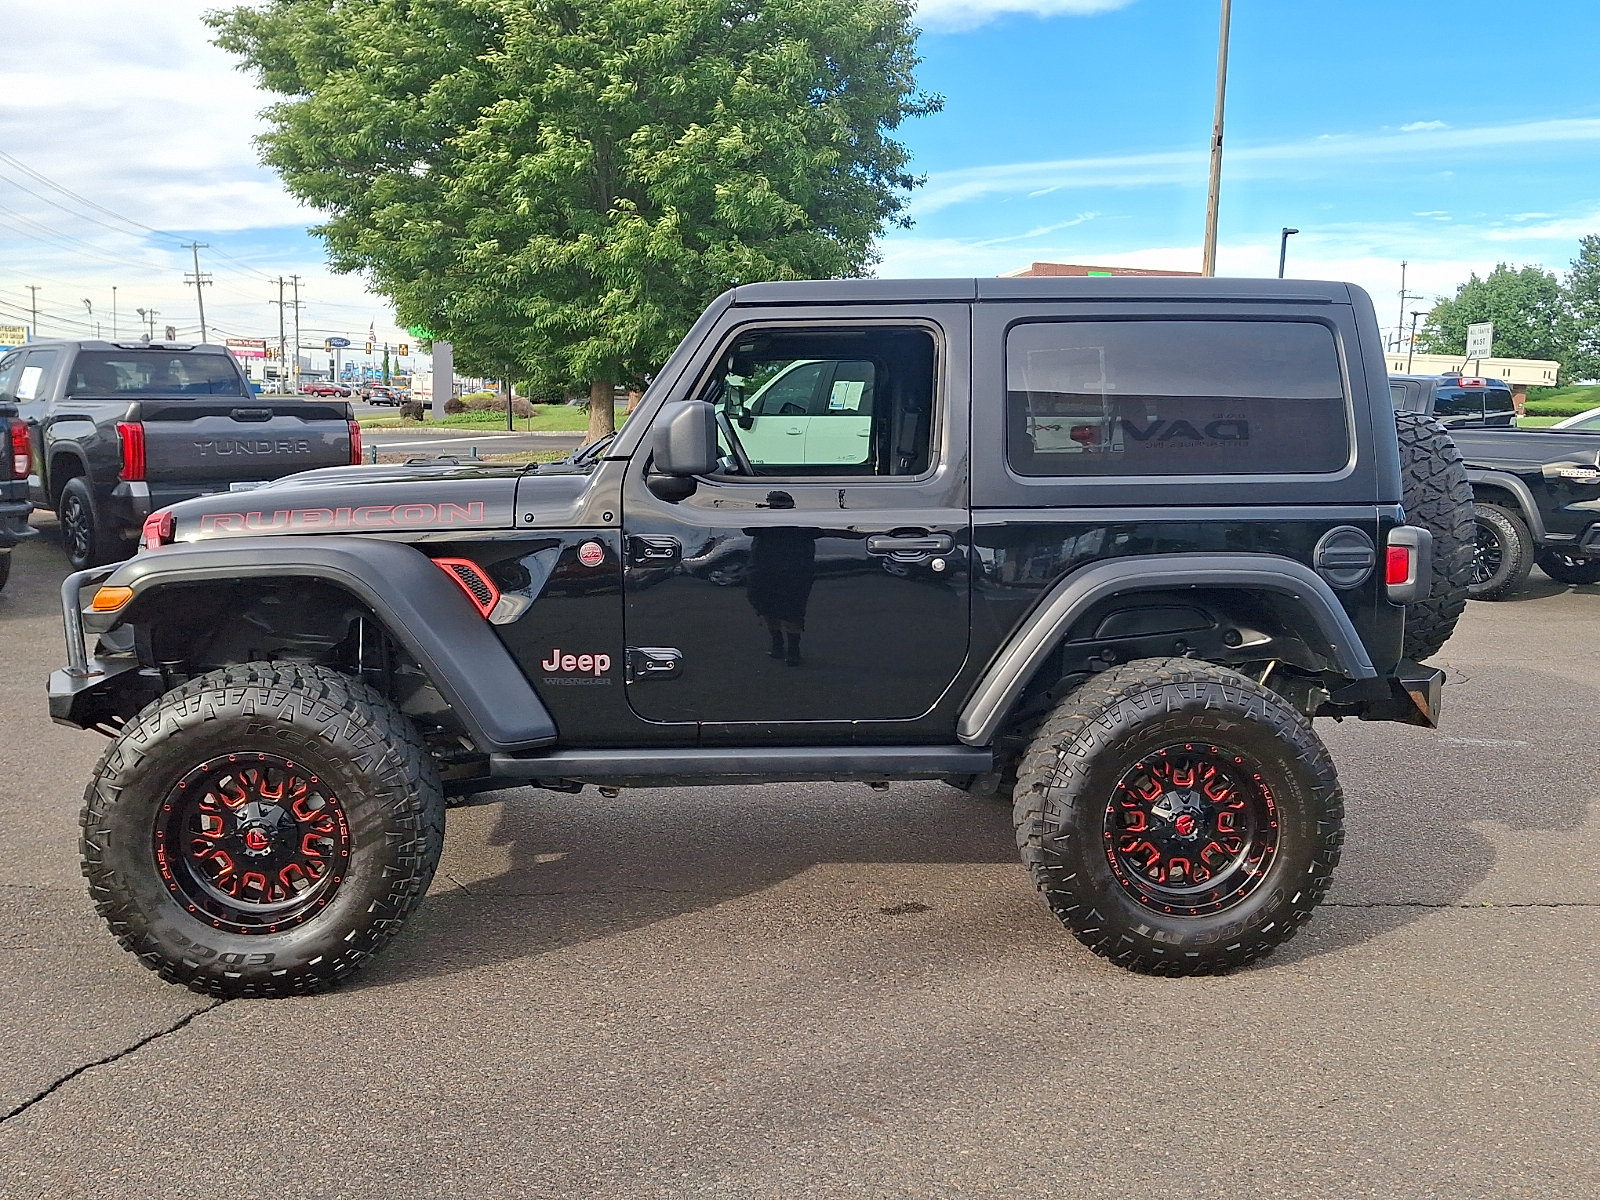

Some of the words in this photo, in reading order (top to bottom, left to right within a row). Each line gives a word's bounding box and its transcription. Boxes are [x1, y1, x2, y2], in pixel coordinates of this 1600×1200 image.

[193, 440, 311, 456] TUNDRA
[201, 501, 485, 535] RUBICON
[541, 648, 612, 677] Jeep
[1259, 782, 1276, 817] FUEL
[334, 808, 349, 845] FUEL
[157, 843, 172, 880] FUEL
[1106, 843, 1123, 877] FUEL
